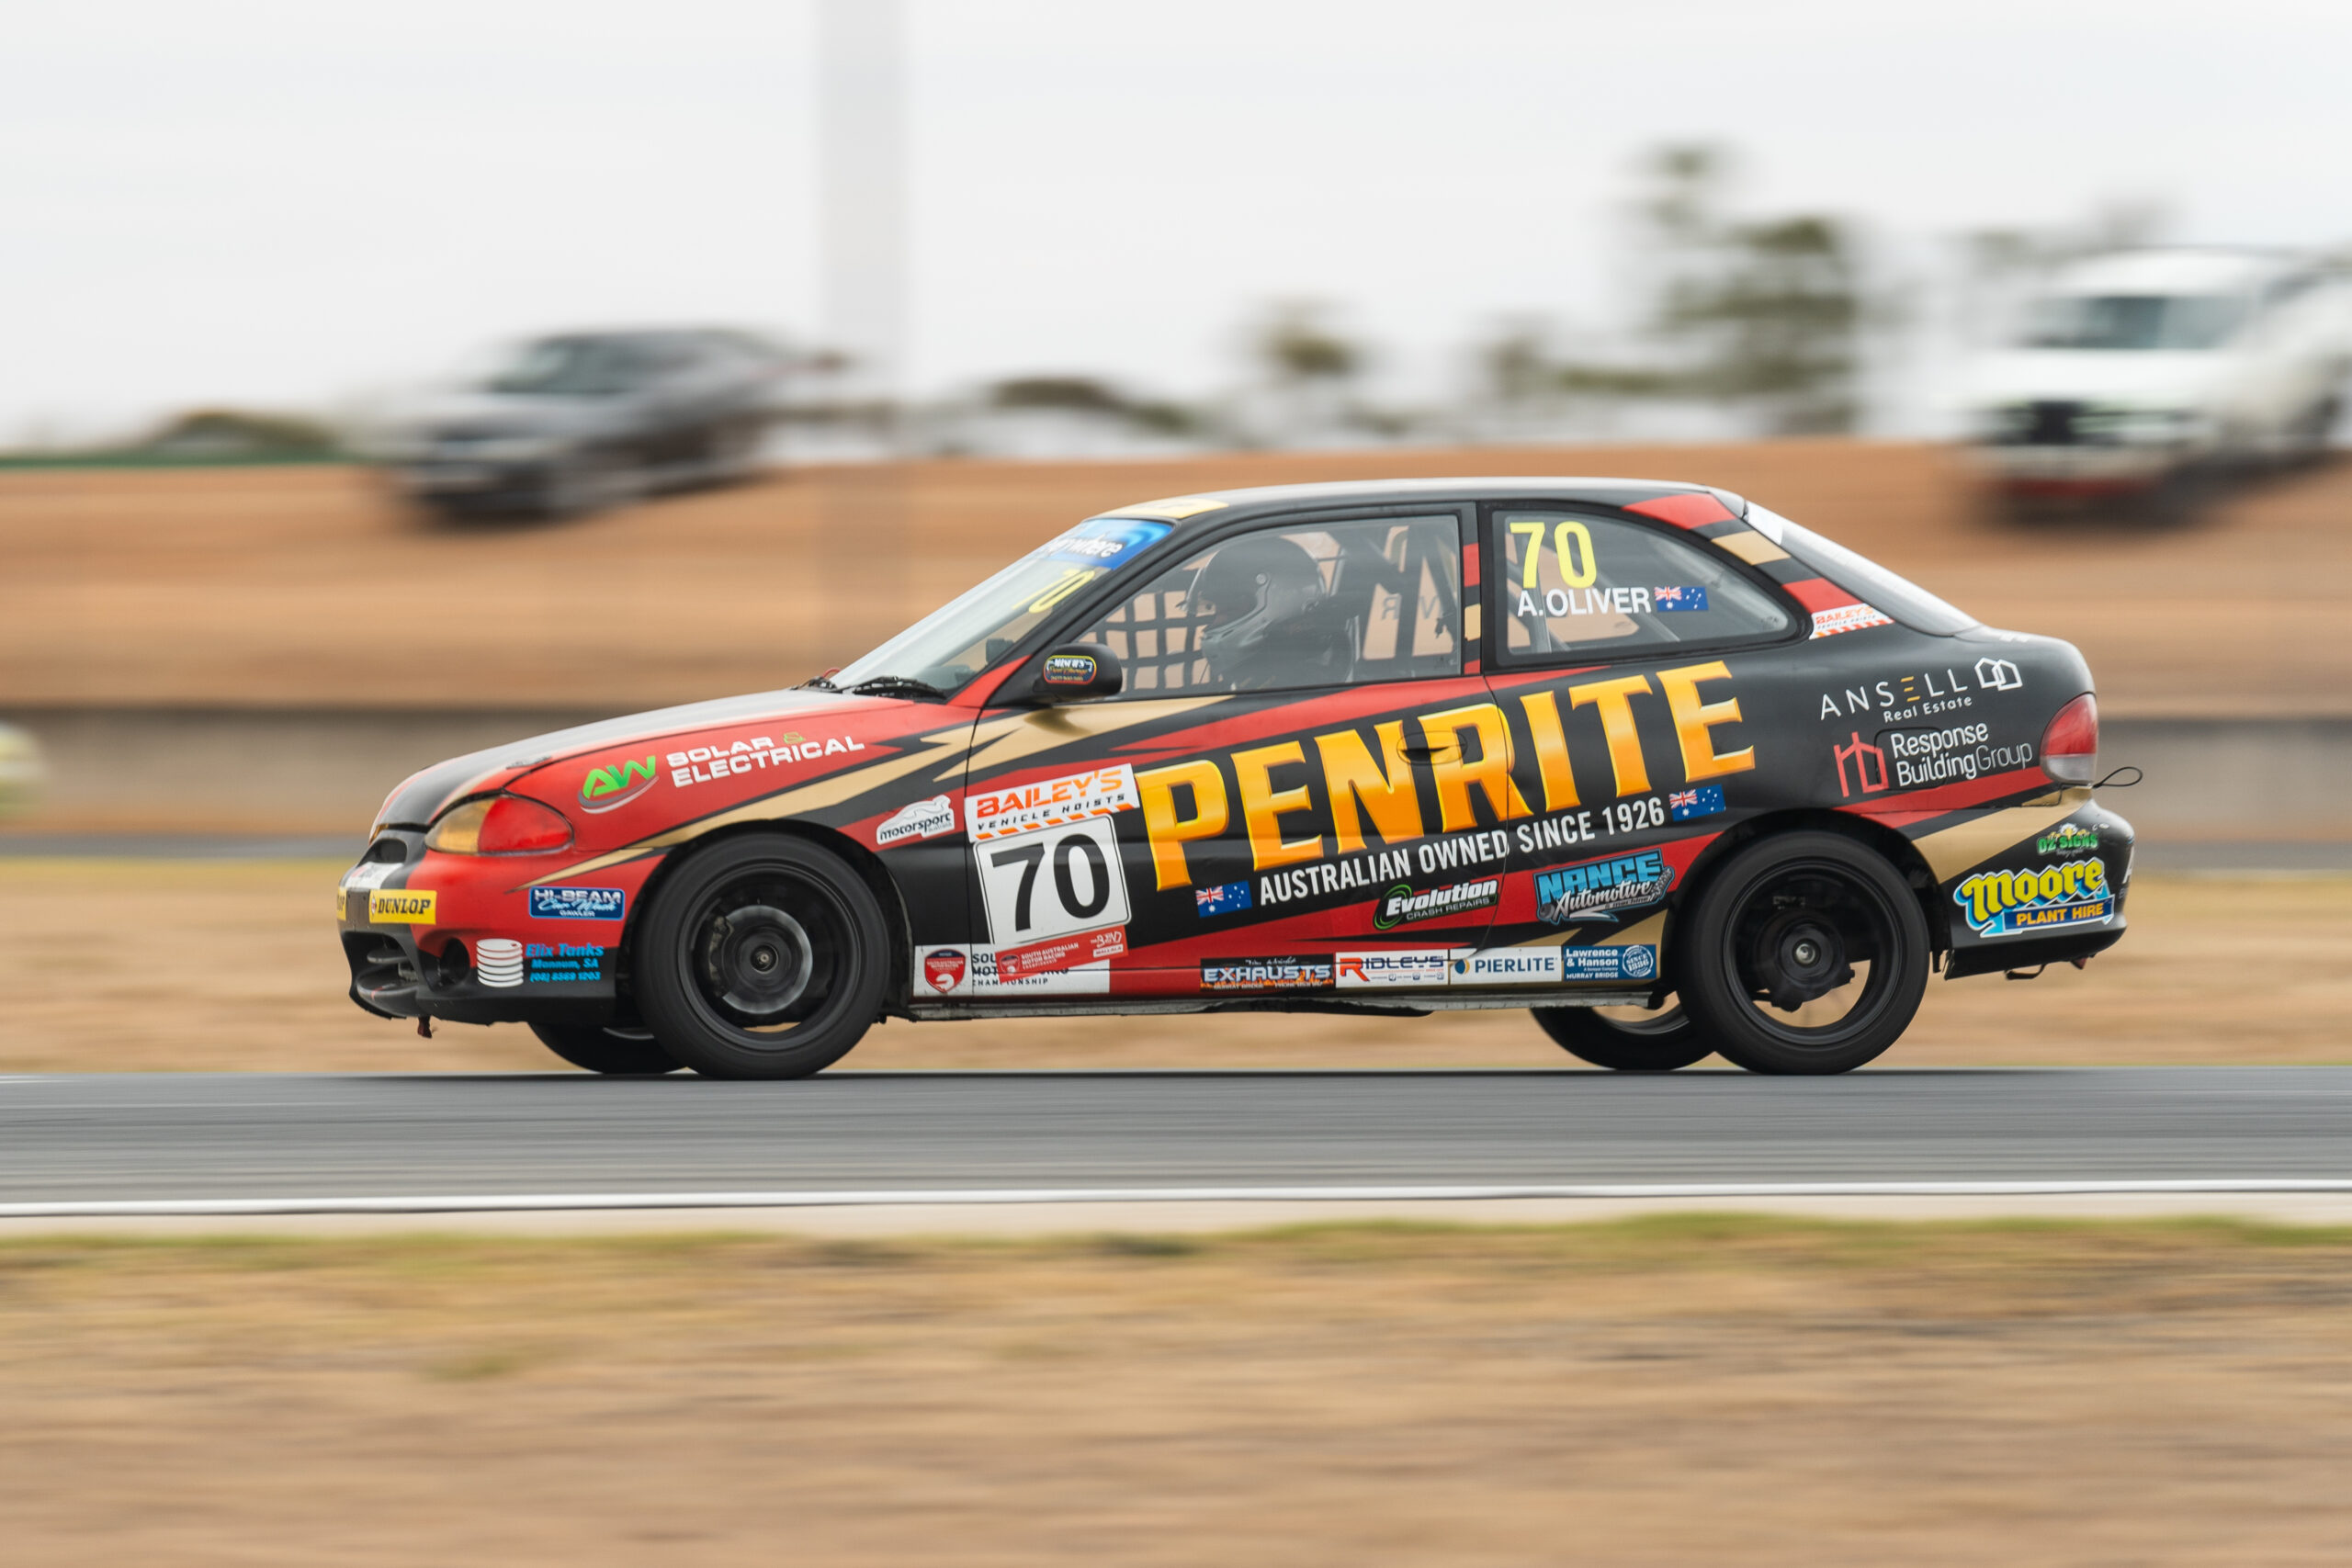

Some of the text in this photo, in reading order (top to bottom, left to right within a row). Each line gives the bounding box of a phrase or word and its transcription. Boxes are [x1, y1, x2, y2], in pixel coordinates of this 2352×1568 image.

[1510, 521, 1597, 589] 70
[1820, 669, 1969, 721] ANSELL
[1883, 695, 1973, 724] Real Estate
[666, 737, 775, 768] SOLAR
[1890, 722, 1989, 760] Response
[671, 736, 865, 788] ELECTRICAL
[1134, 660, 1756, 893] PENRITE
[582, 756, 657, 799] AW
[977, 770, 1124, 819] BAILEY'S
[879, 812, 951, 841] motorsport
[978, 794, 1125, 831] VEHICLE HOISTS
[1260, 796, 1665, 906] AUSTRALIAN OWNED SINCE 1926
[990, 833, 1110, 932] 70
[1538, 852, 1660, 901] NANCE
[378, 898, 431, 915] DUNLOP
[534, 889, 621, 905] HI-BEAM
[1386, 880, 1498, 917] Evolution
[1406, 897, 1490, 921] CRASH REPAIRS
[1553, 877, 1656, 920] Automotive
[2016, 902, 2105, 927] PLANT HIRE
[526, 942, 605, 957] Elix Tanks
[582, 958, 599, 968] SA
[1566, 948, 1618, 958] Lawrence
[1566, 957, 1619, 967] & Hanson
[1204, 964, 1331, 982] EXHAUSTS
[1340, 955, 1445, 982] RIDLEYS
[1475, 956, 1555, 974] PIERLITE
[1566, 971, 1619, 980] MURRAY BRIDGE
